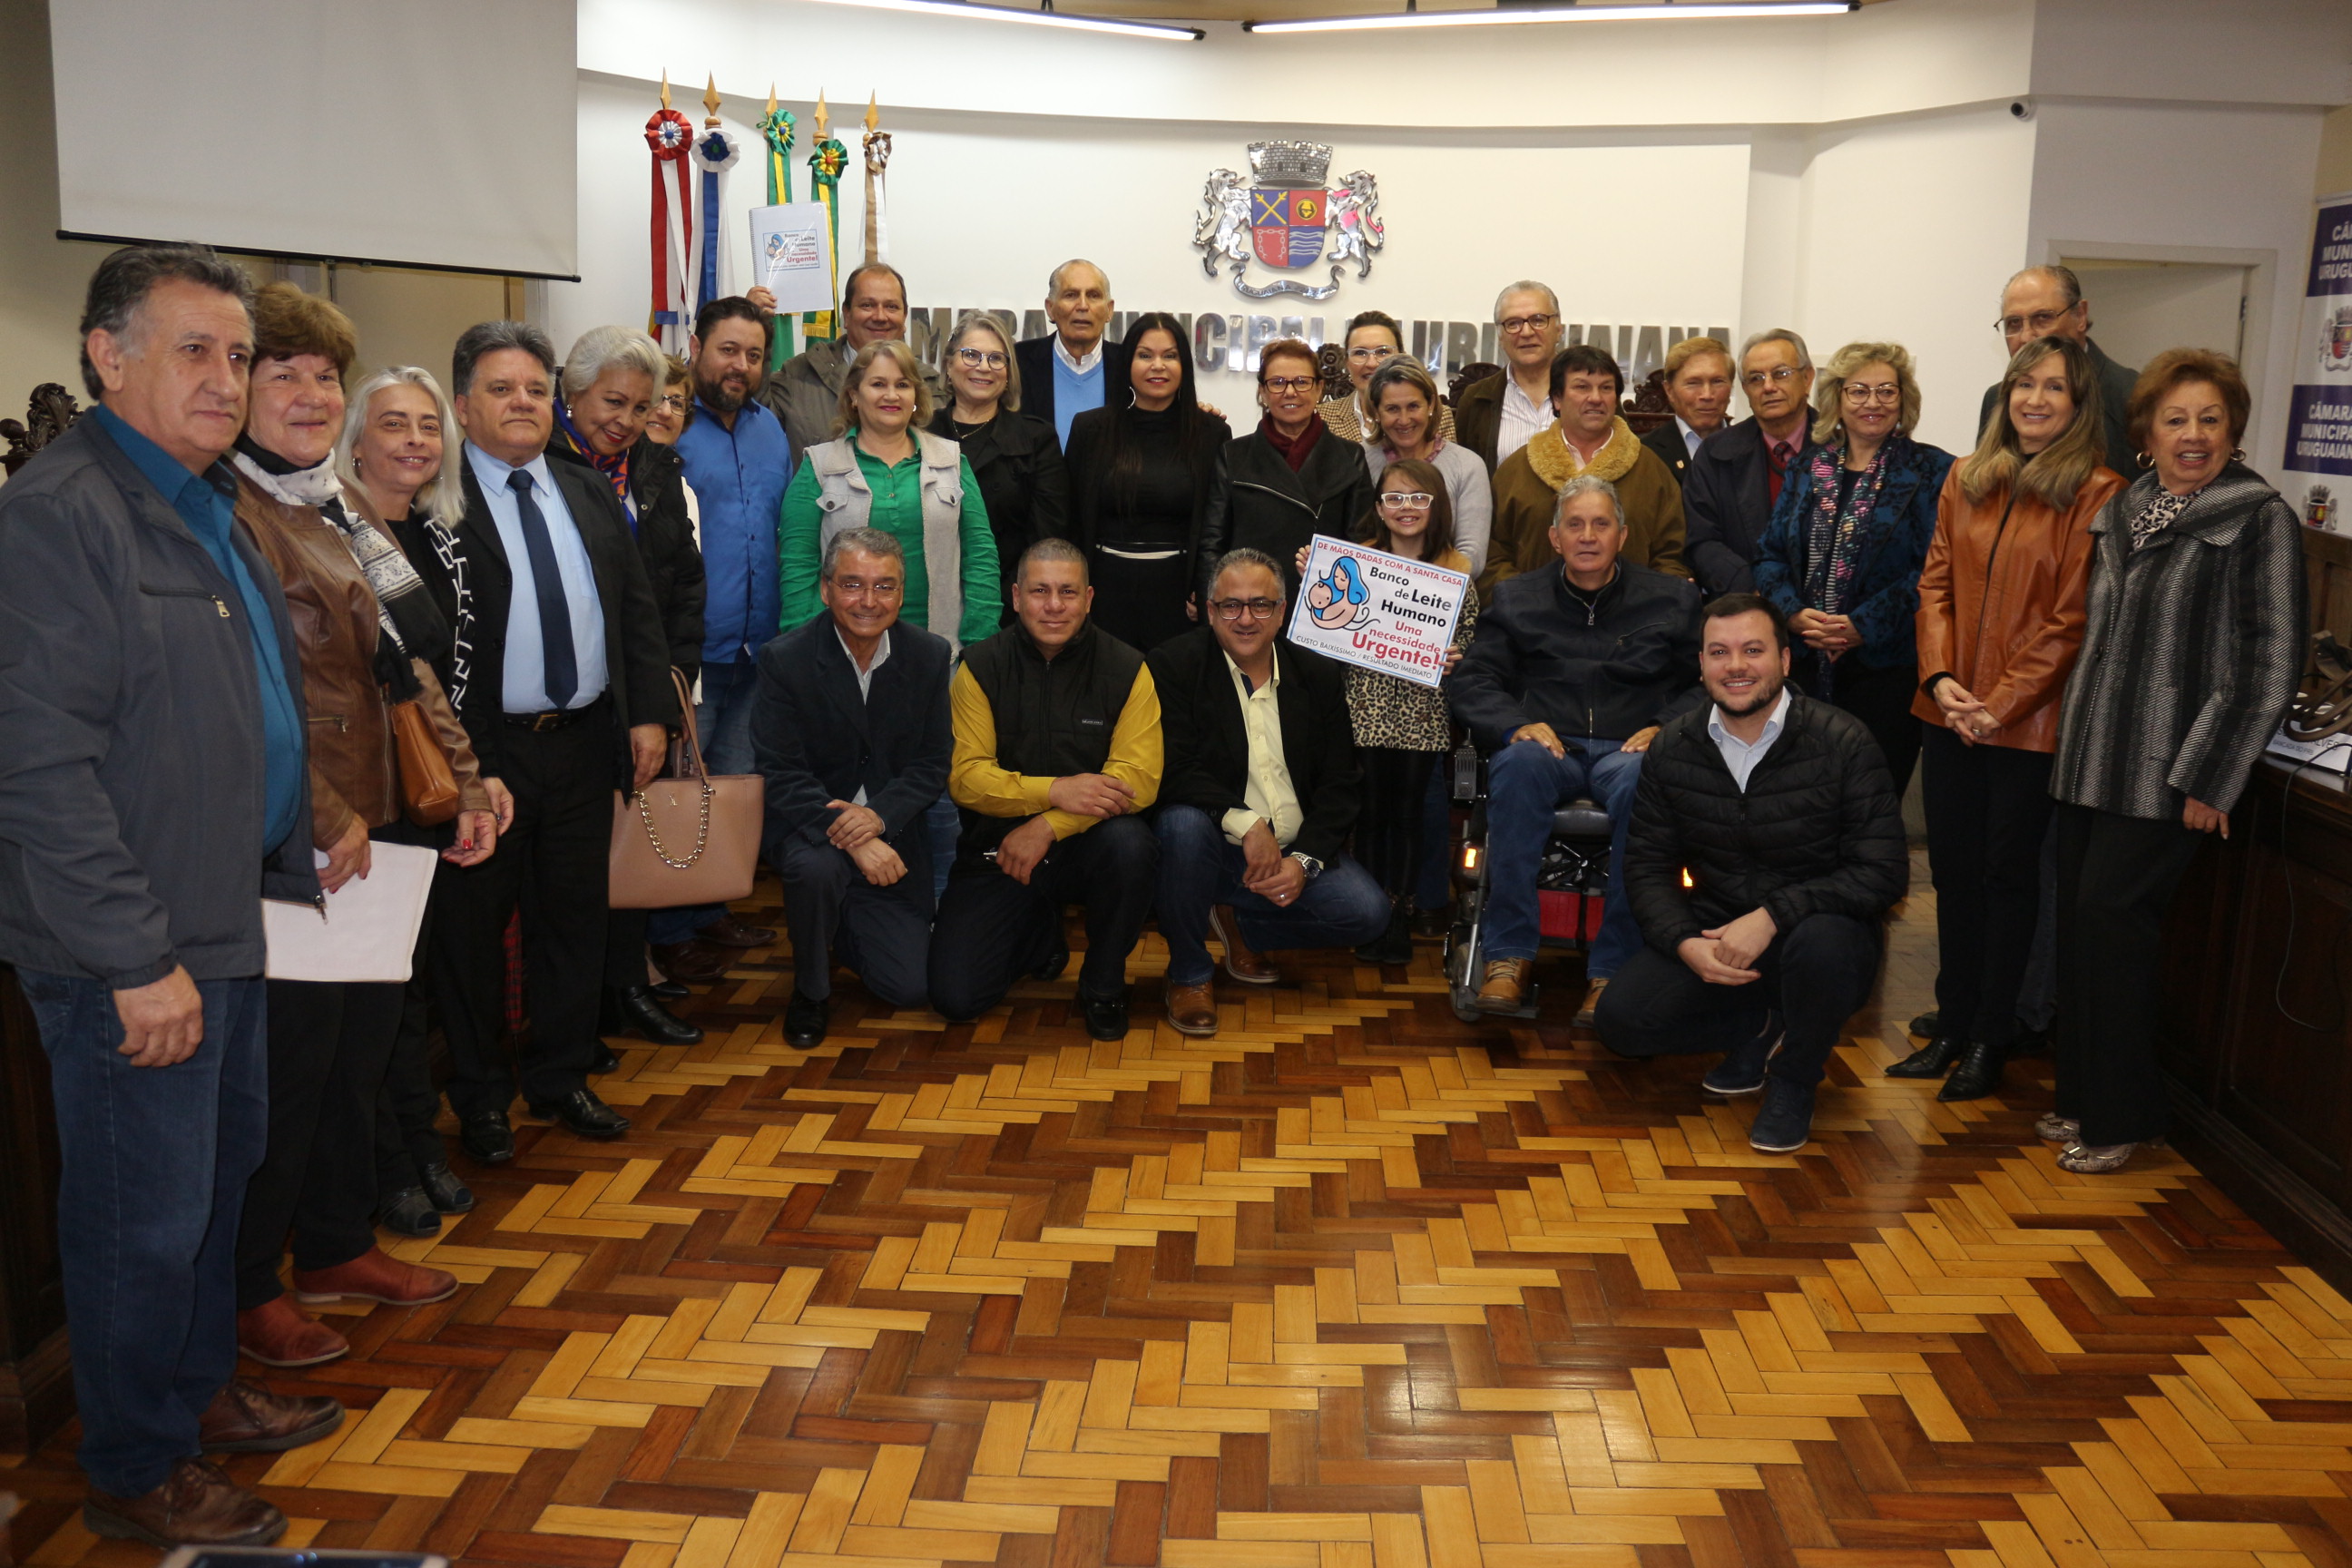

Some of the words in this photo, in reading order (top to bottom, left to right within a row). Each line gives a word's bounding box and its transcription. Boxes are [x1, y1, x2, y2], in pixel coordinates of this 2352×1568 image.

[1318, 542, 1328, 550] DE
[1356, 552, 1383, 564] DADAS
[1385, 560, 1403, 570] COM
[1413, 567, 1439, 580] SANTA
[1441, 575, 1462, 586] CASA
[1369, 566, 1409, 586] Banco
[1395, 588, 1409, 600] de
[1411, 589, 1452, 611] Leite
[1381, 599, 1446, 627] Humano
[1369, 629, 1441, 653] necessidade
[1395, 621, 1423, 636] Uma
[1296, 635, 1318, 646] CUSTO
[1362, 654, 1399, 670] RESULTADO
[1400, 665, 1433, 679] IMEDIATO
[1352, 632, 1440, 670] Urgente!
